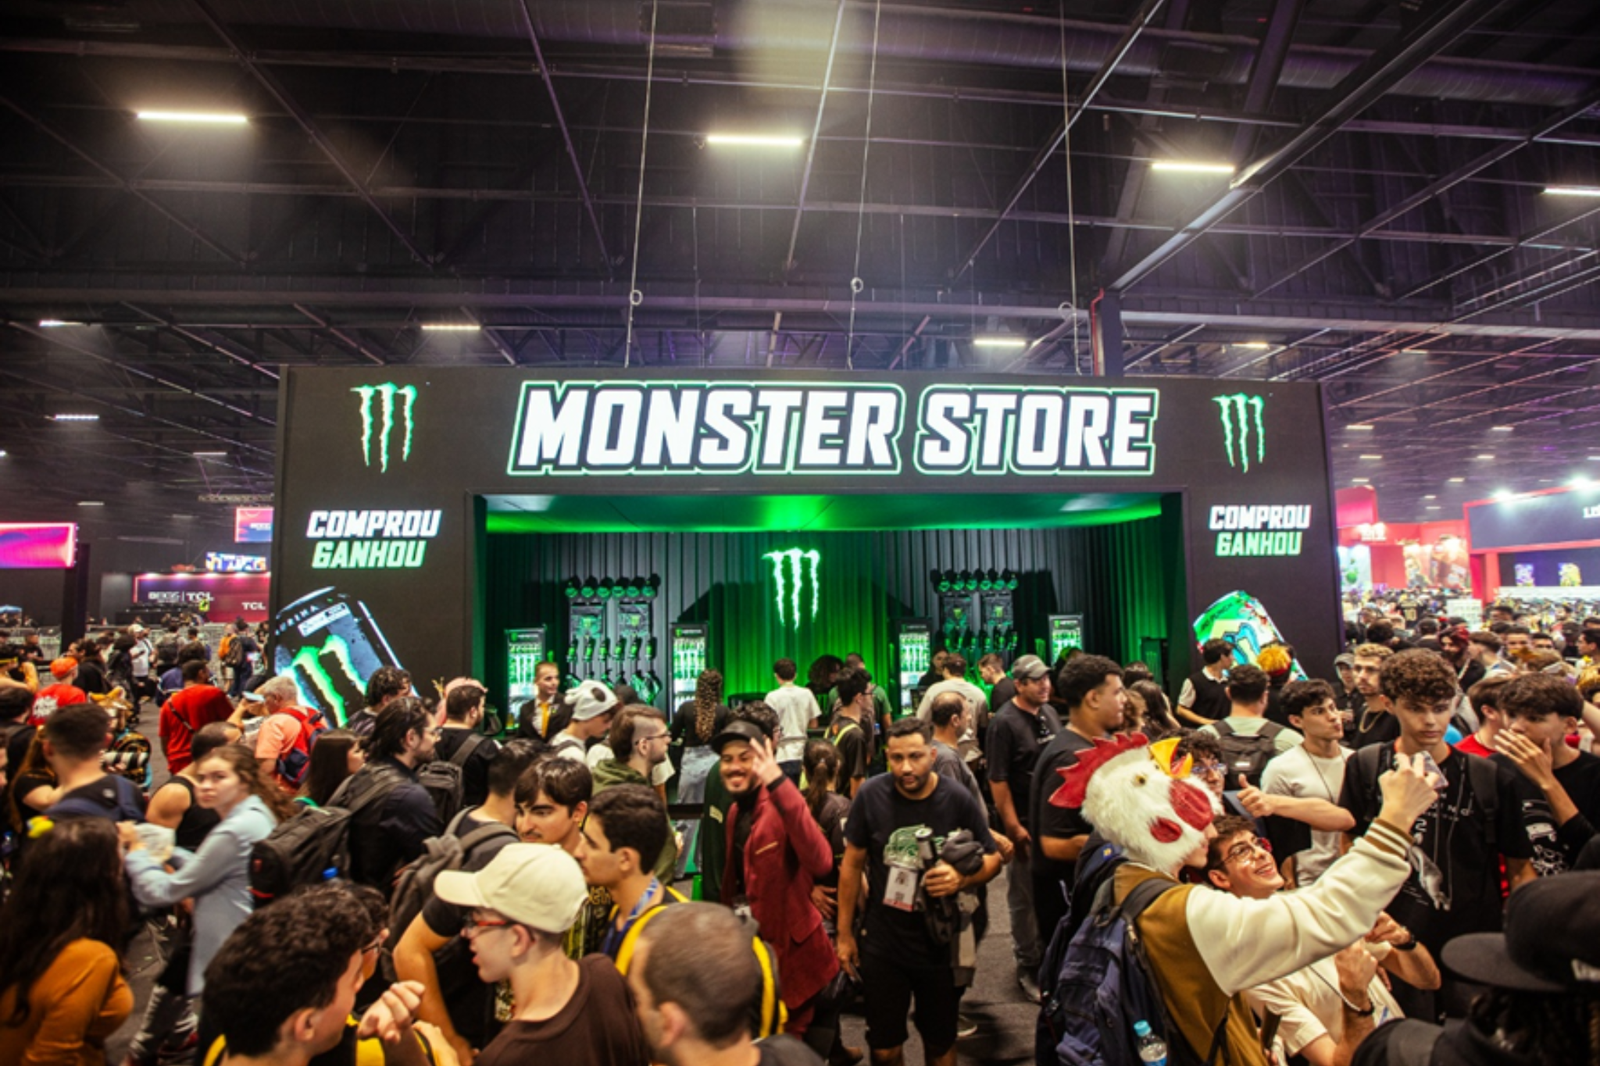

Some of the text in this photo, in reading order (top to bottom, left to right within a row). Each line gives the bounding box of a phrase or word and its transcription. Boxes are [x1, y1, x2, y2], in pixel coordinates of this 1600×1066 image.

[508, 381, 1159, 475] MONSTER STORE
[306, 510, 442, 537] COMPROU
[1208, 505, 1311, 529] COMPROU
[311, 540, 427, 568] GANHOU
[1216, 531, 1302, 556] GANHOU
[187, 592, 214, 602] TCL
[242, 602, 266, 610] TCL
